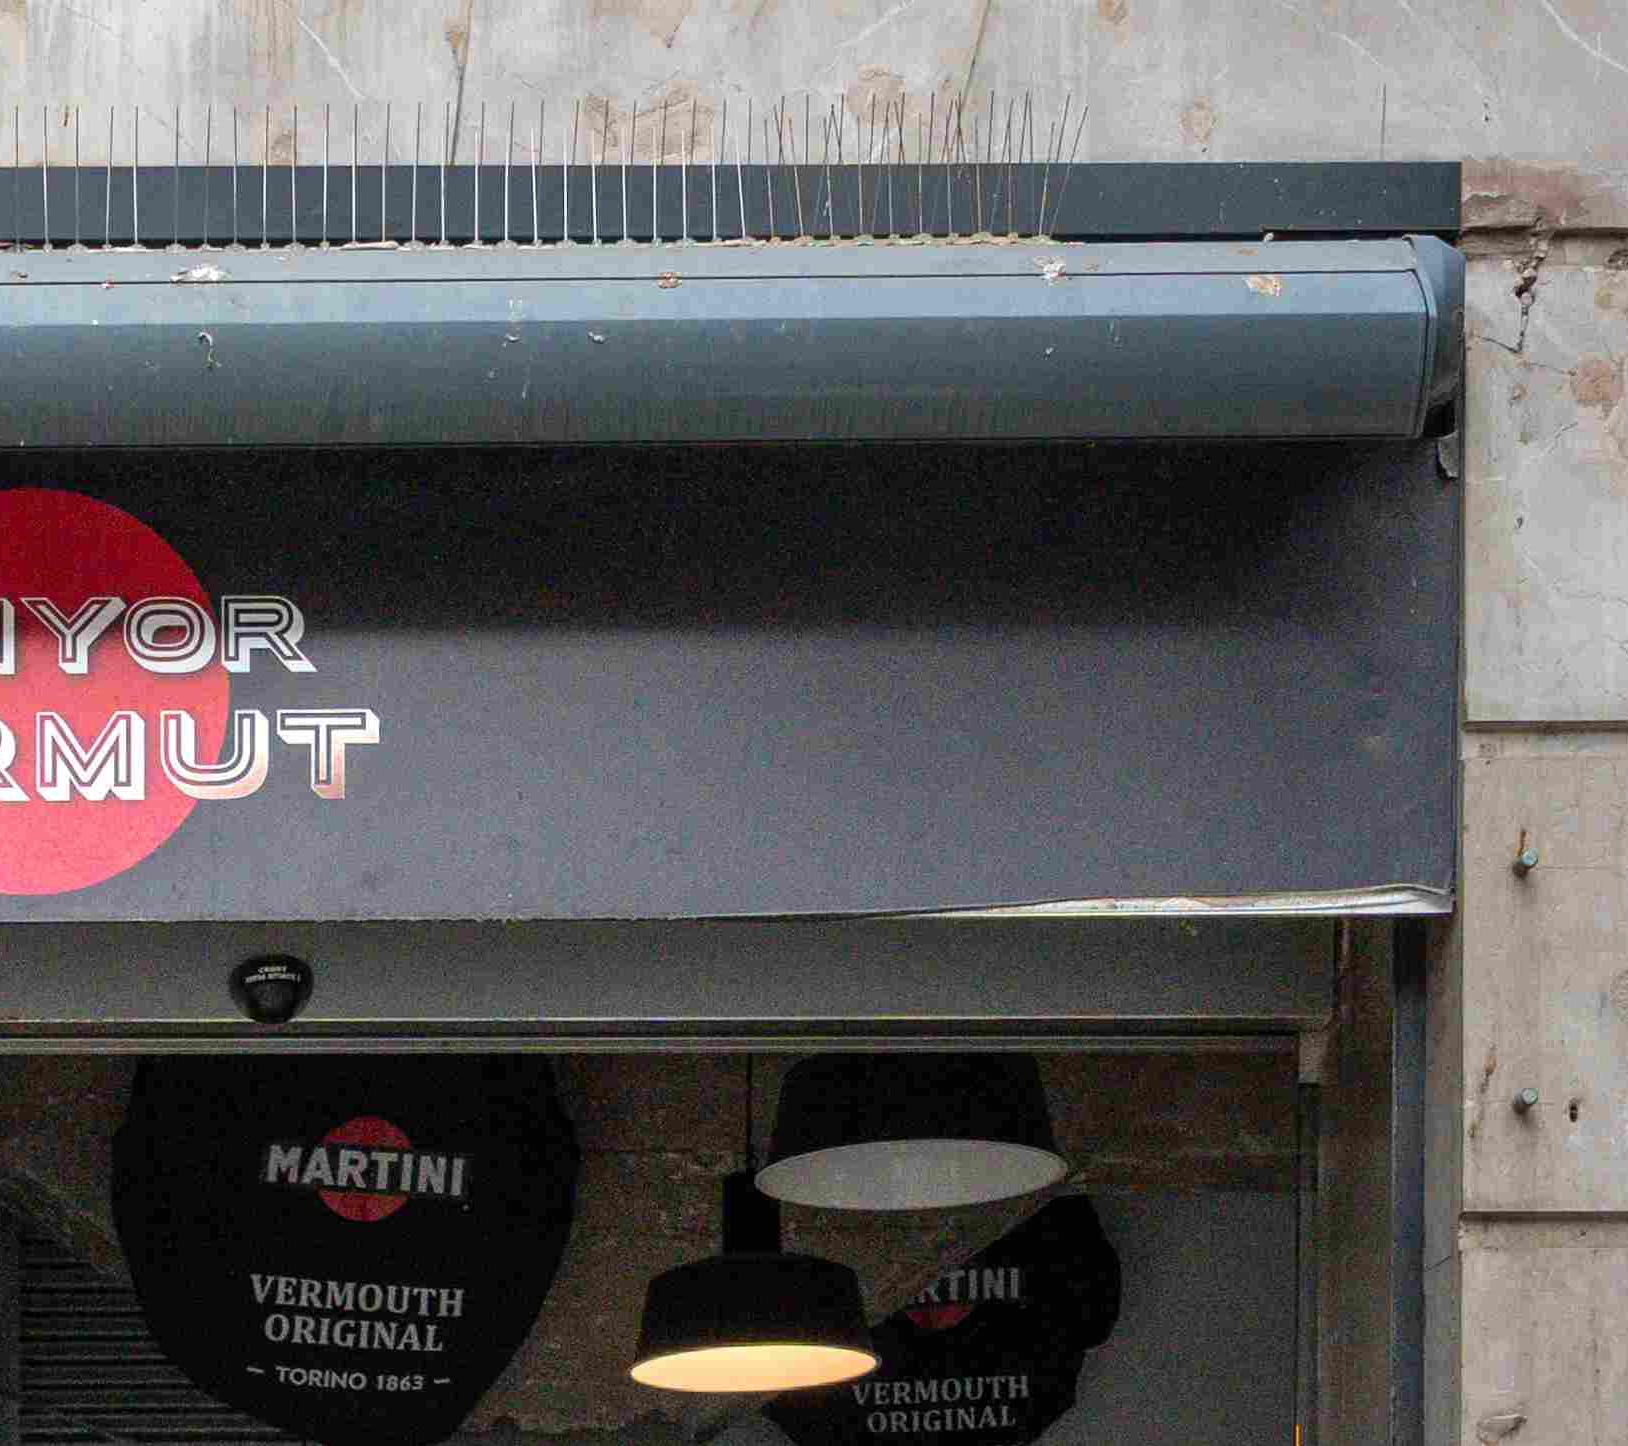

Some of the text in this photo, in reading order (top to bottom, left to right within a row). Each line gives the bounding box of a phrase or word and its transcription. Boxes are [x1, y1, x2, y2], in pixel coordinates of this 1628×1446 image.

[265, 1141, 471, 1199] MARTINI
[248, 1273, 465, 1320] VERMOUTH
[263, 1313, 445, 1353] ORIGINAL
[274, 1365, 427, 1393] TORINO 1863
[852, 1375, 1030, 1406] VERMOUTH
[866, 1404, 1017, 1434] ORIGINAL
